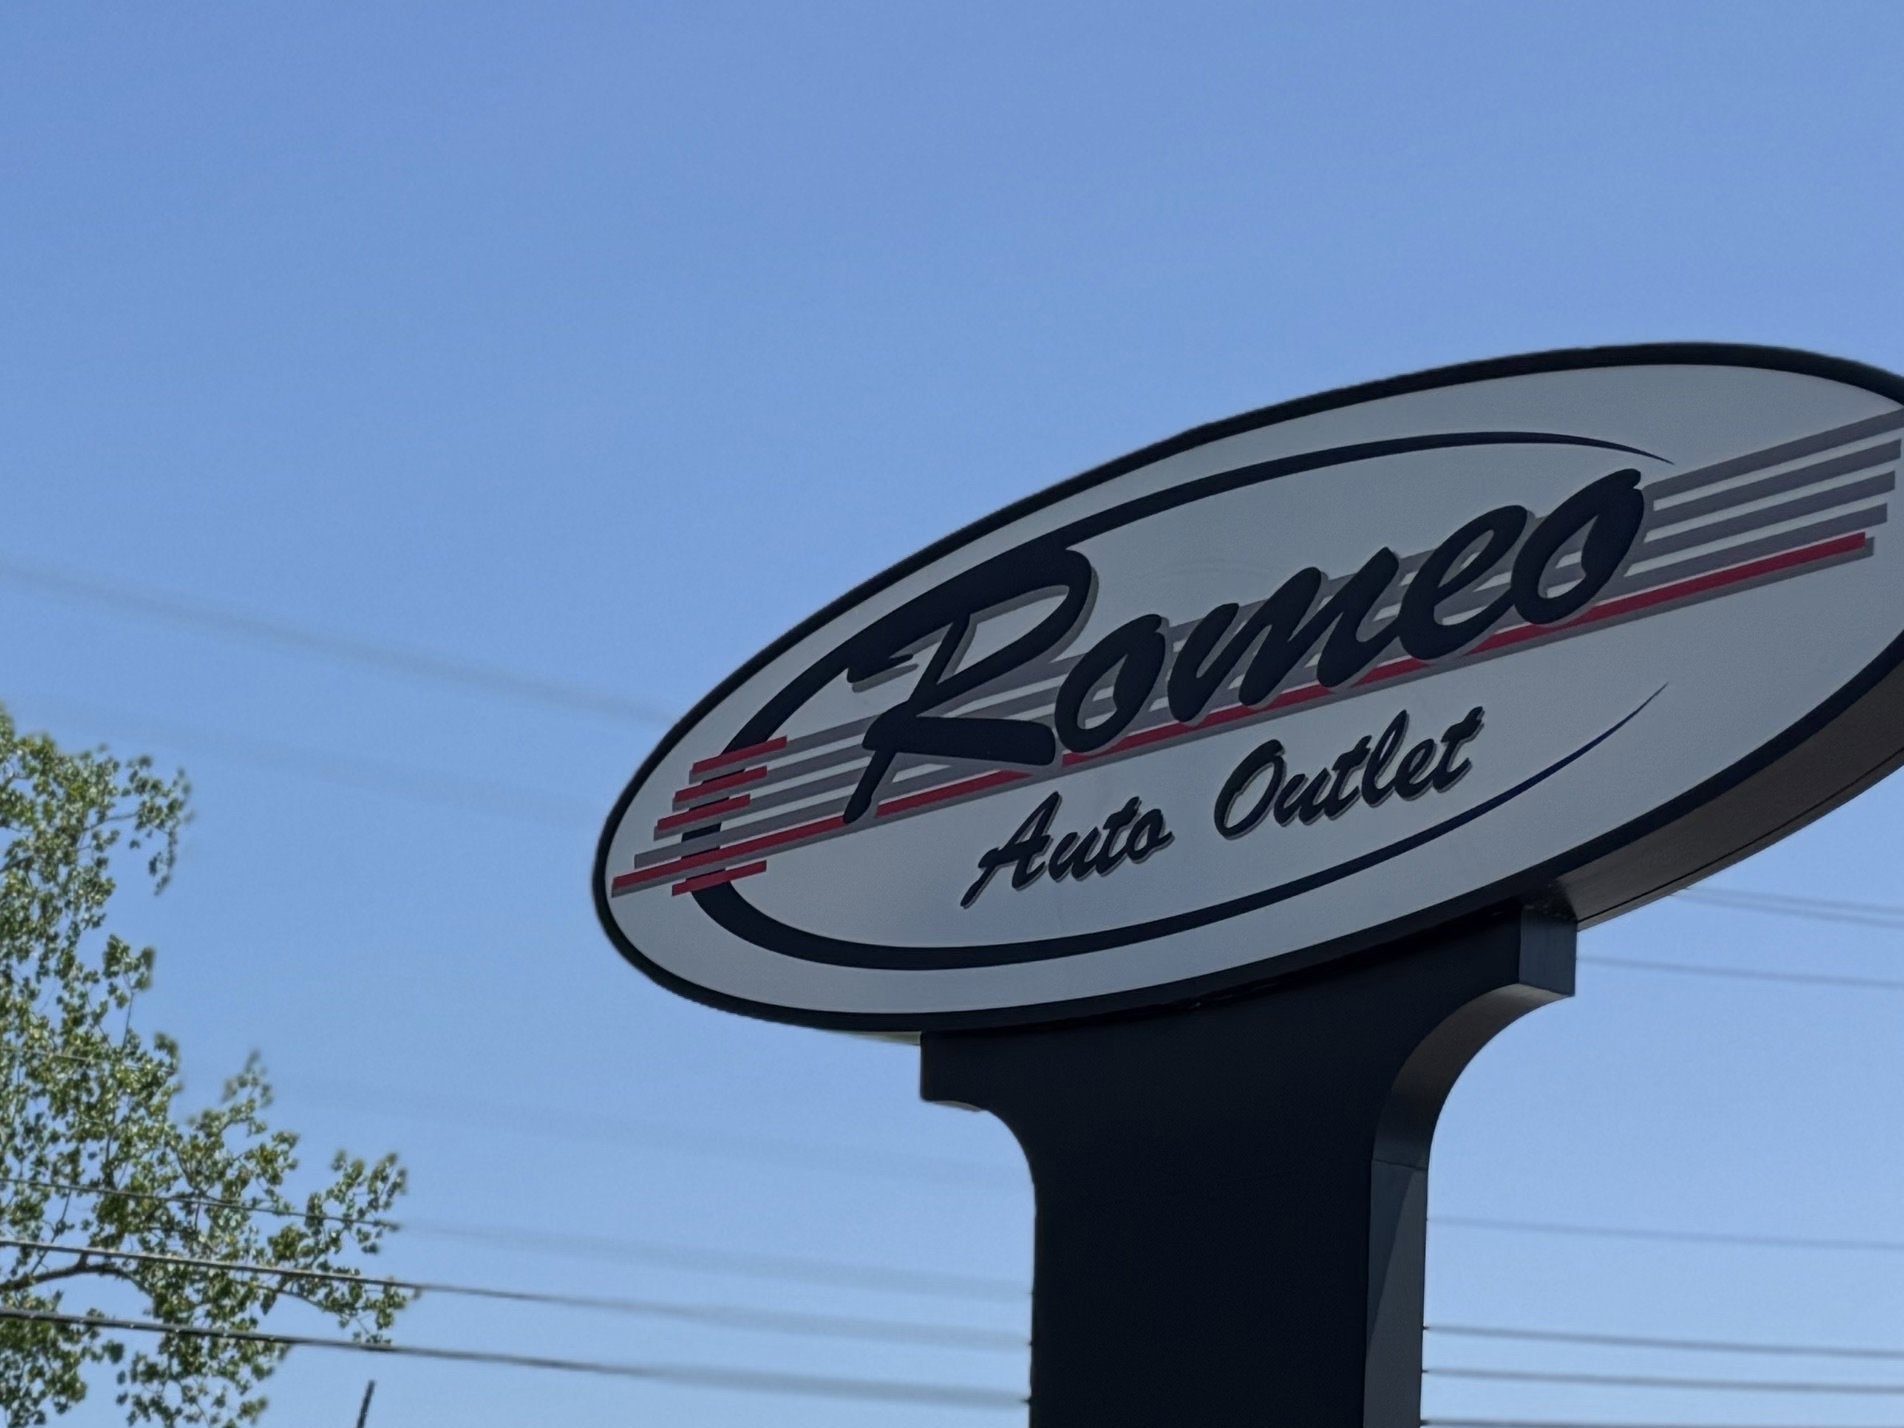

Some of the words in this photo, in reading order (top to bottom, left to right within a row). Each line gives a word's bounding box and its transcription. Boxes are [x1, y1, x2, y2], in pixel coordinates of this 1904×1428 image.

[845, 467, 1646, 827] Romeo
[958, 792, 1173, 910] Auto
[1211, 704, 1487, 842] Outlet
